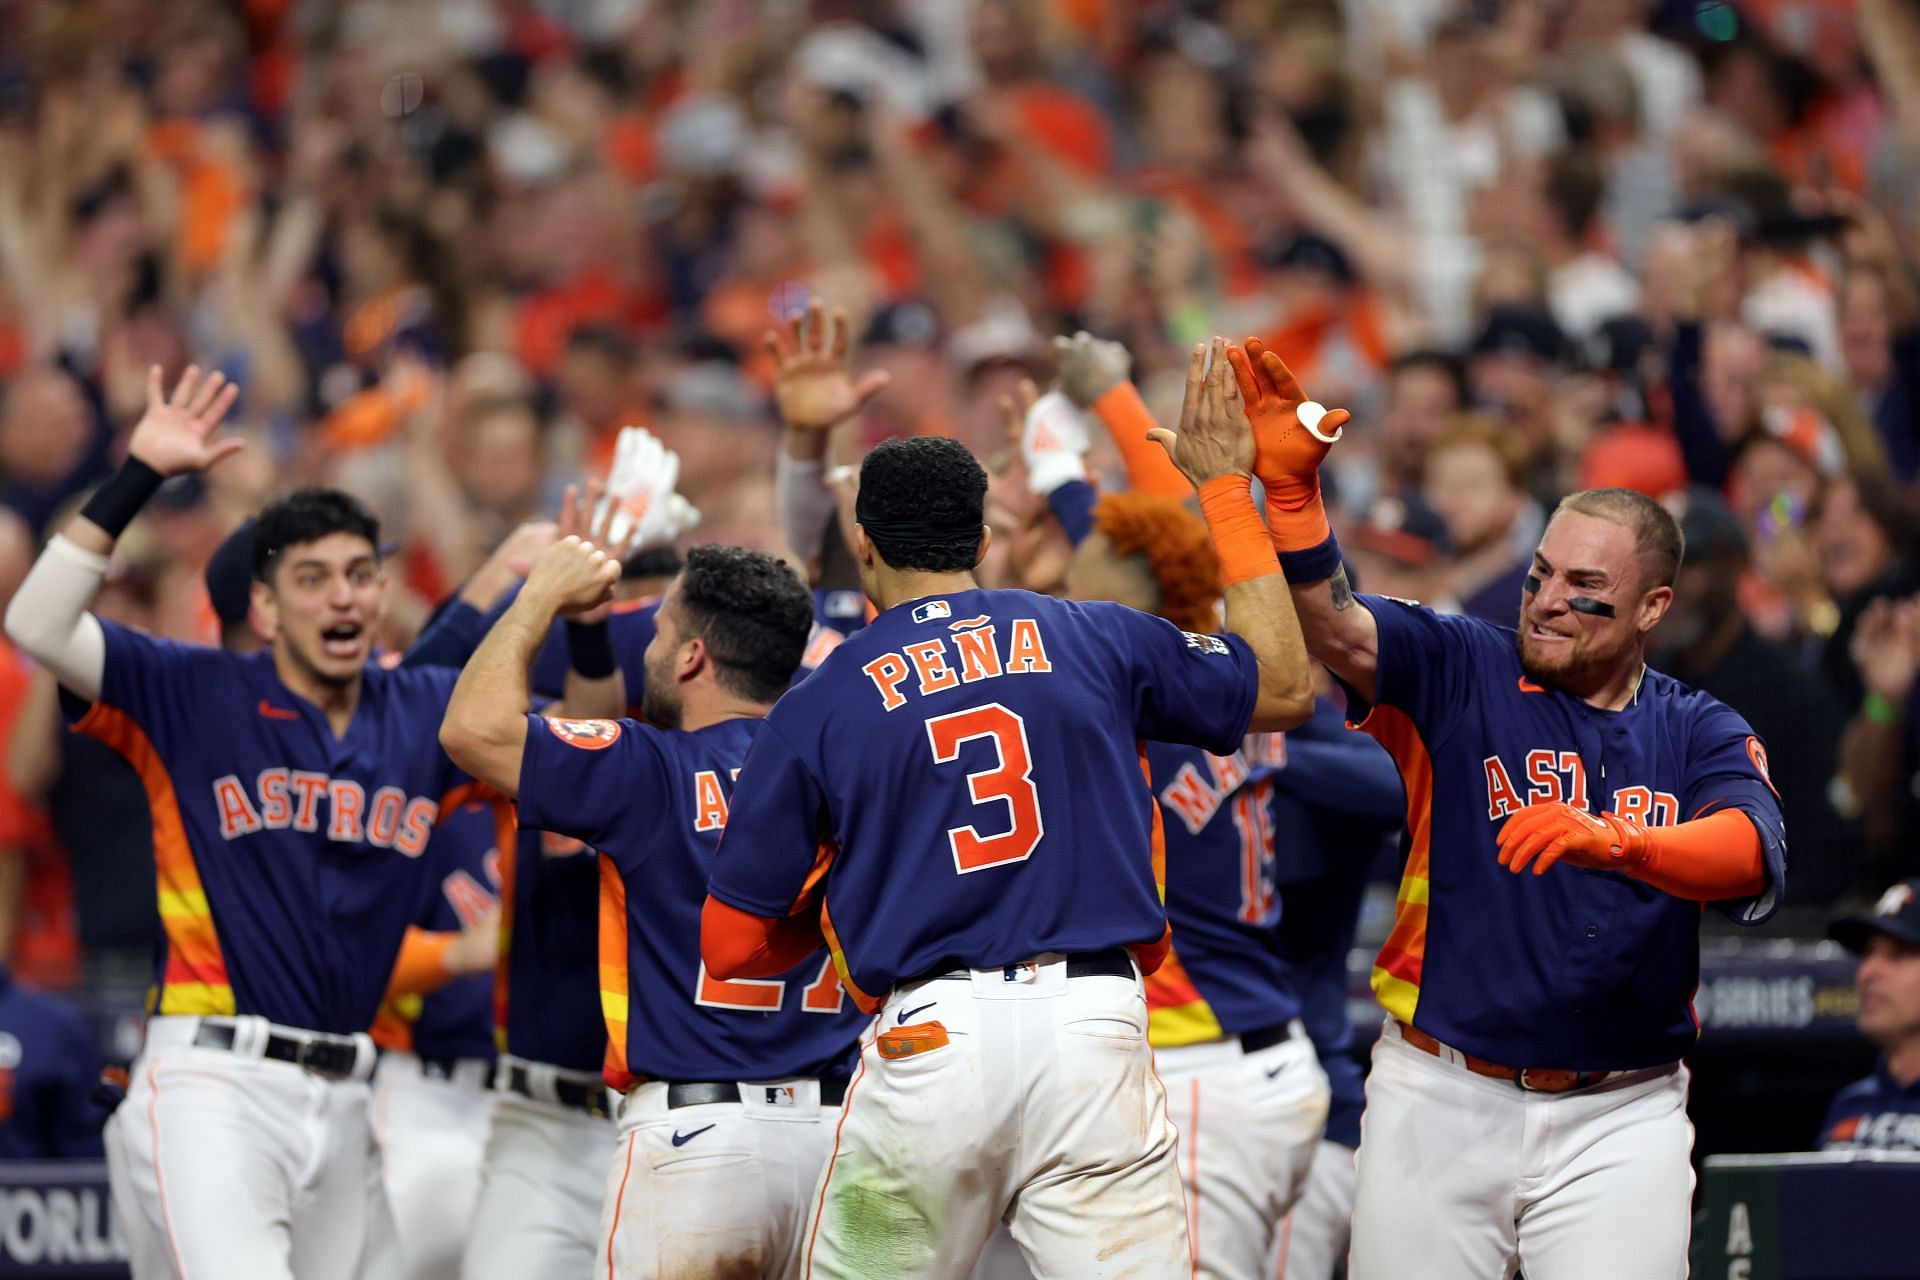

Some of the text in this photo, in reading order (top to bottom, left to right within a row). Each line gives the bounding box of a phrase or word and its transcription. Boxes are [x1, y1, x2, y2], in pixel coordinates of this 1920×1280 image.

[861, 614, 1052, 712] PEÑA
[212, 766, 440, 858] ASTROS
[925, 702, 1044, 875] 3
